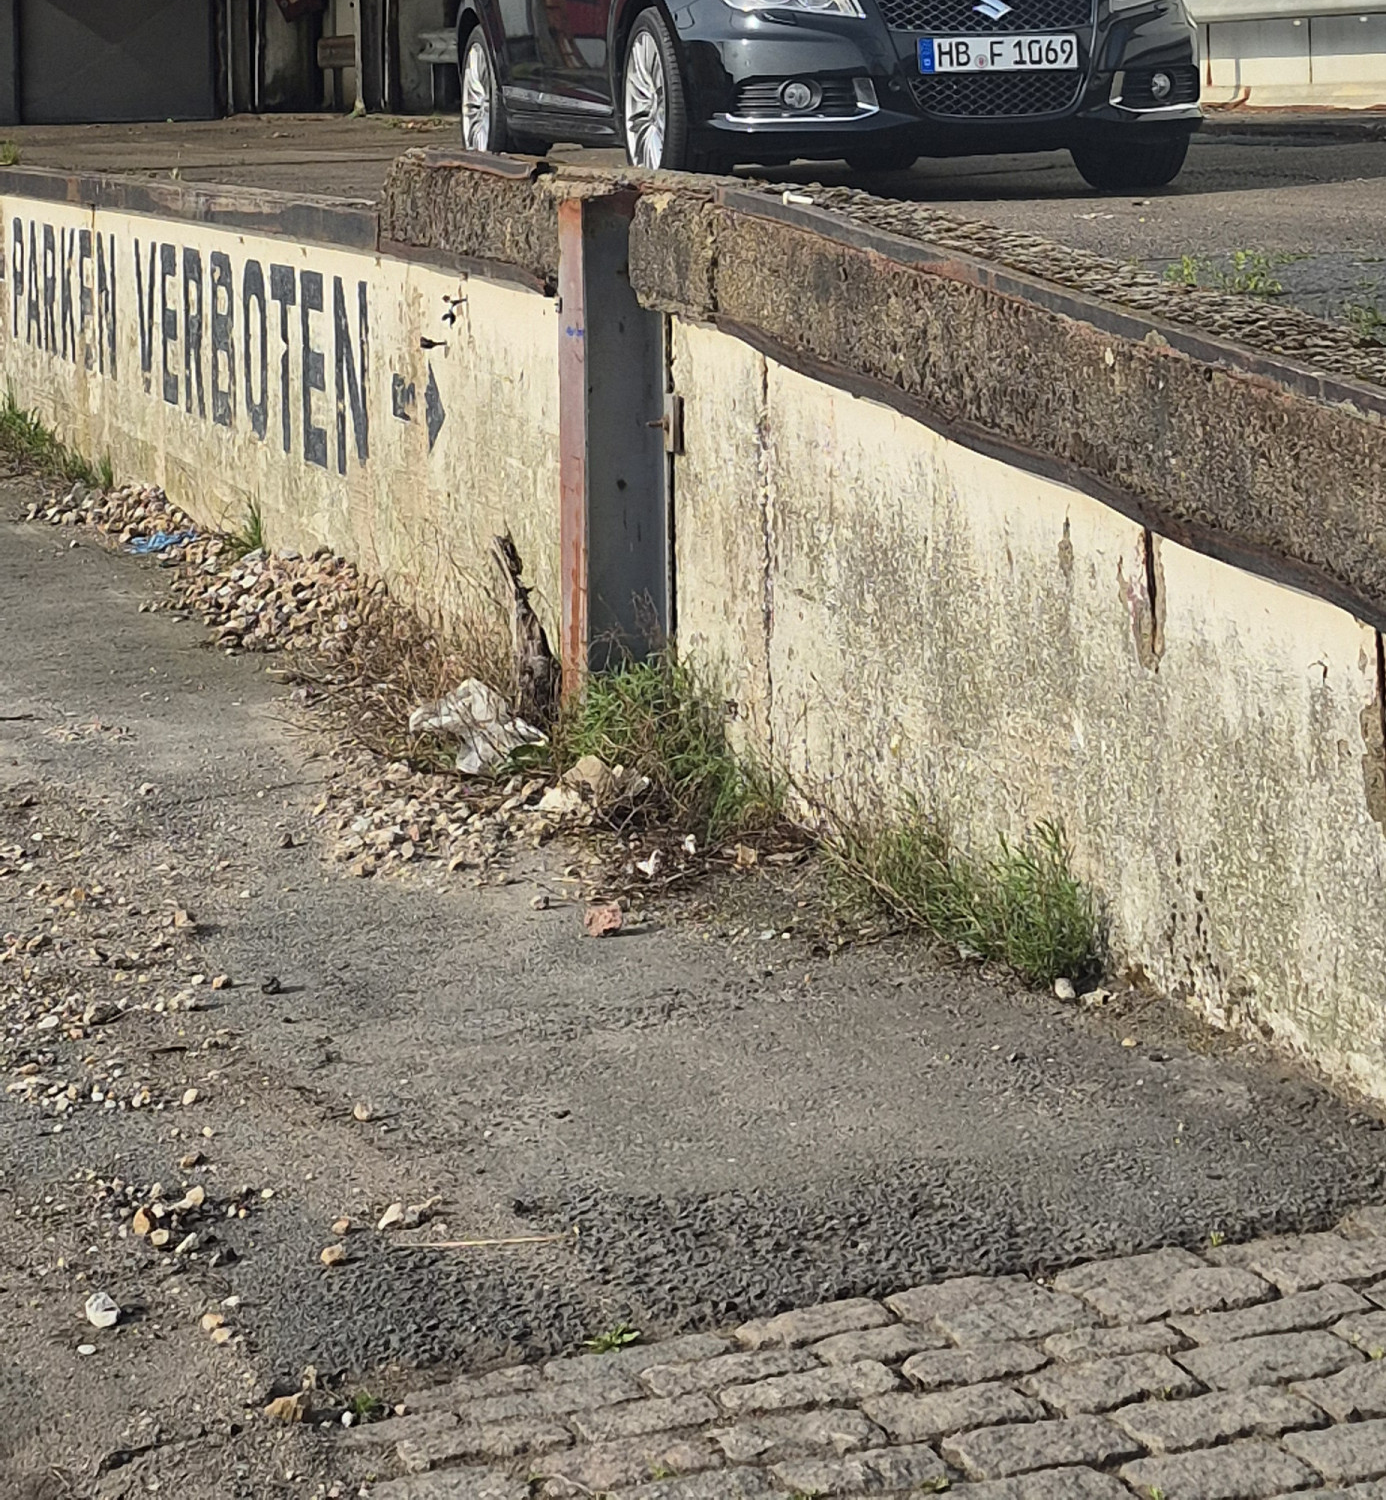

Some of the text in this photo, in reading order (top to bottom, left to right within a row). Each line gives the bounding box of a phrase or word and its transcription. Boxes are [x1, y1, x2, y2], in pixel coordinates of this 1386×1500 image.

[937, 39, 1074, 68] HB F 1069
[12, 217, 370, 476] PARKEN VERBOTEN
